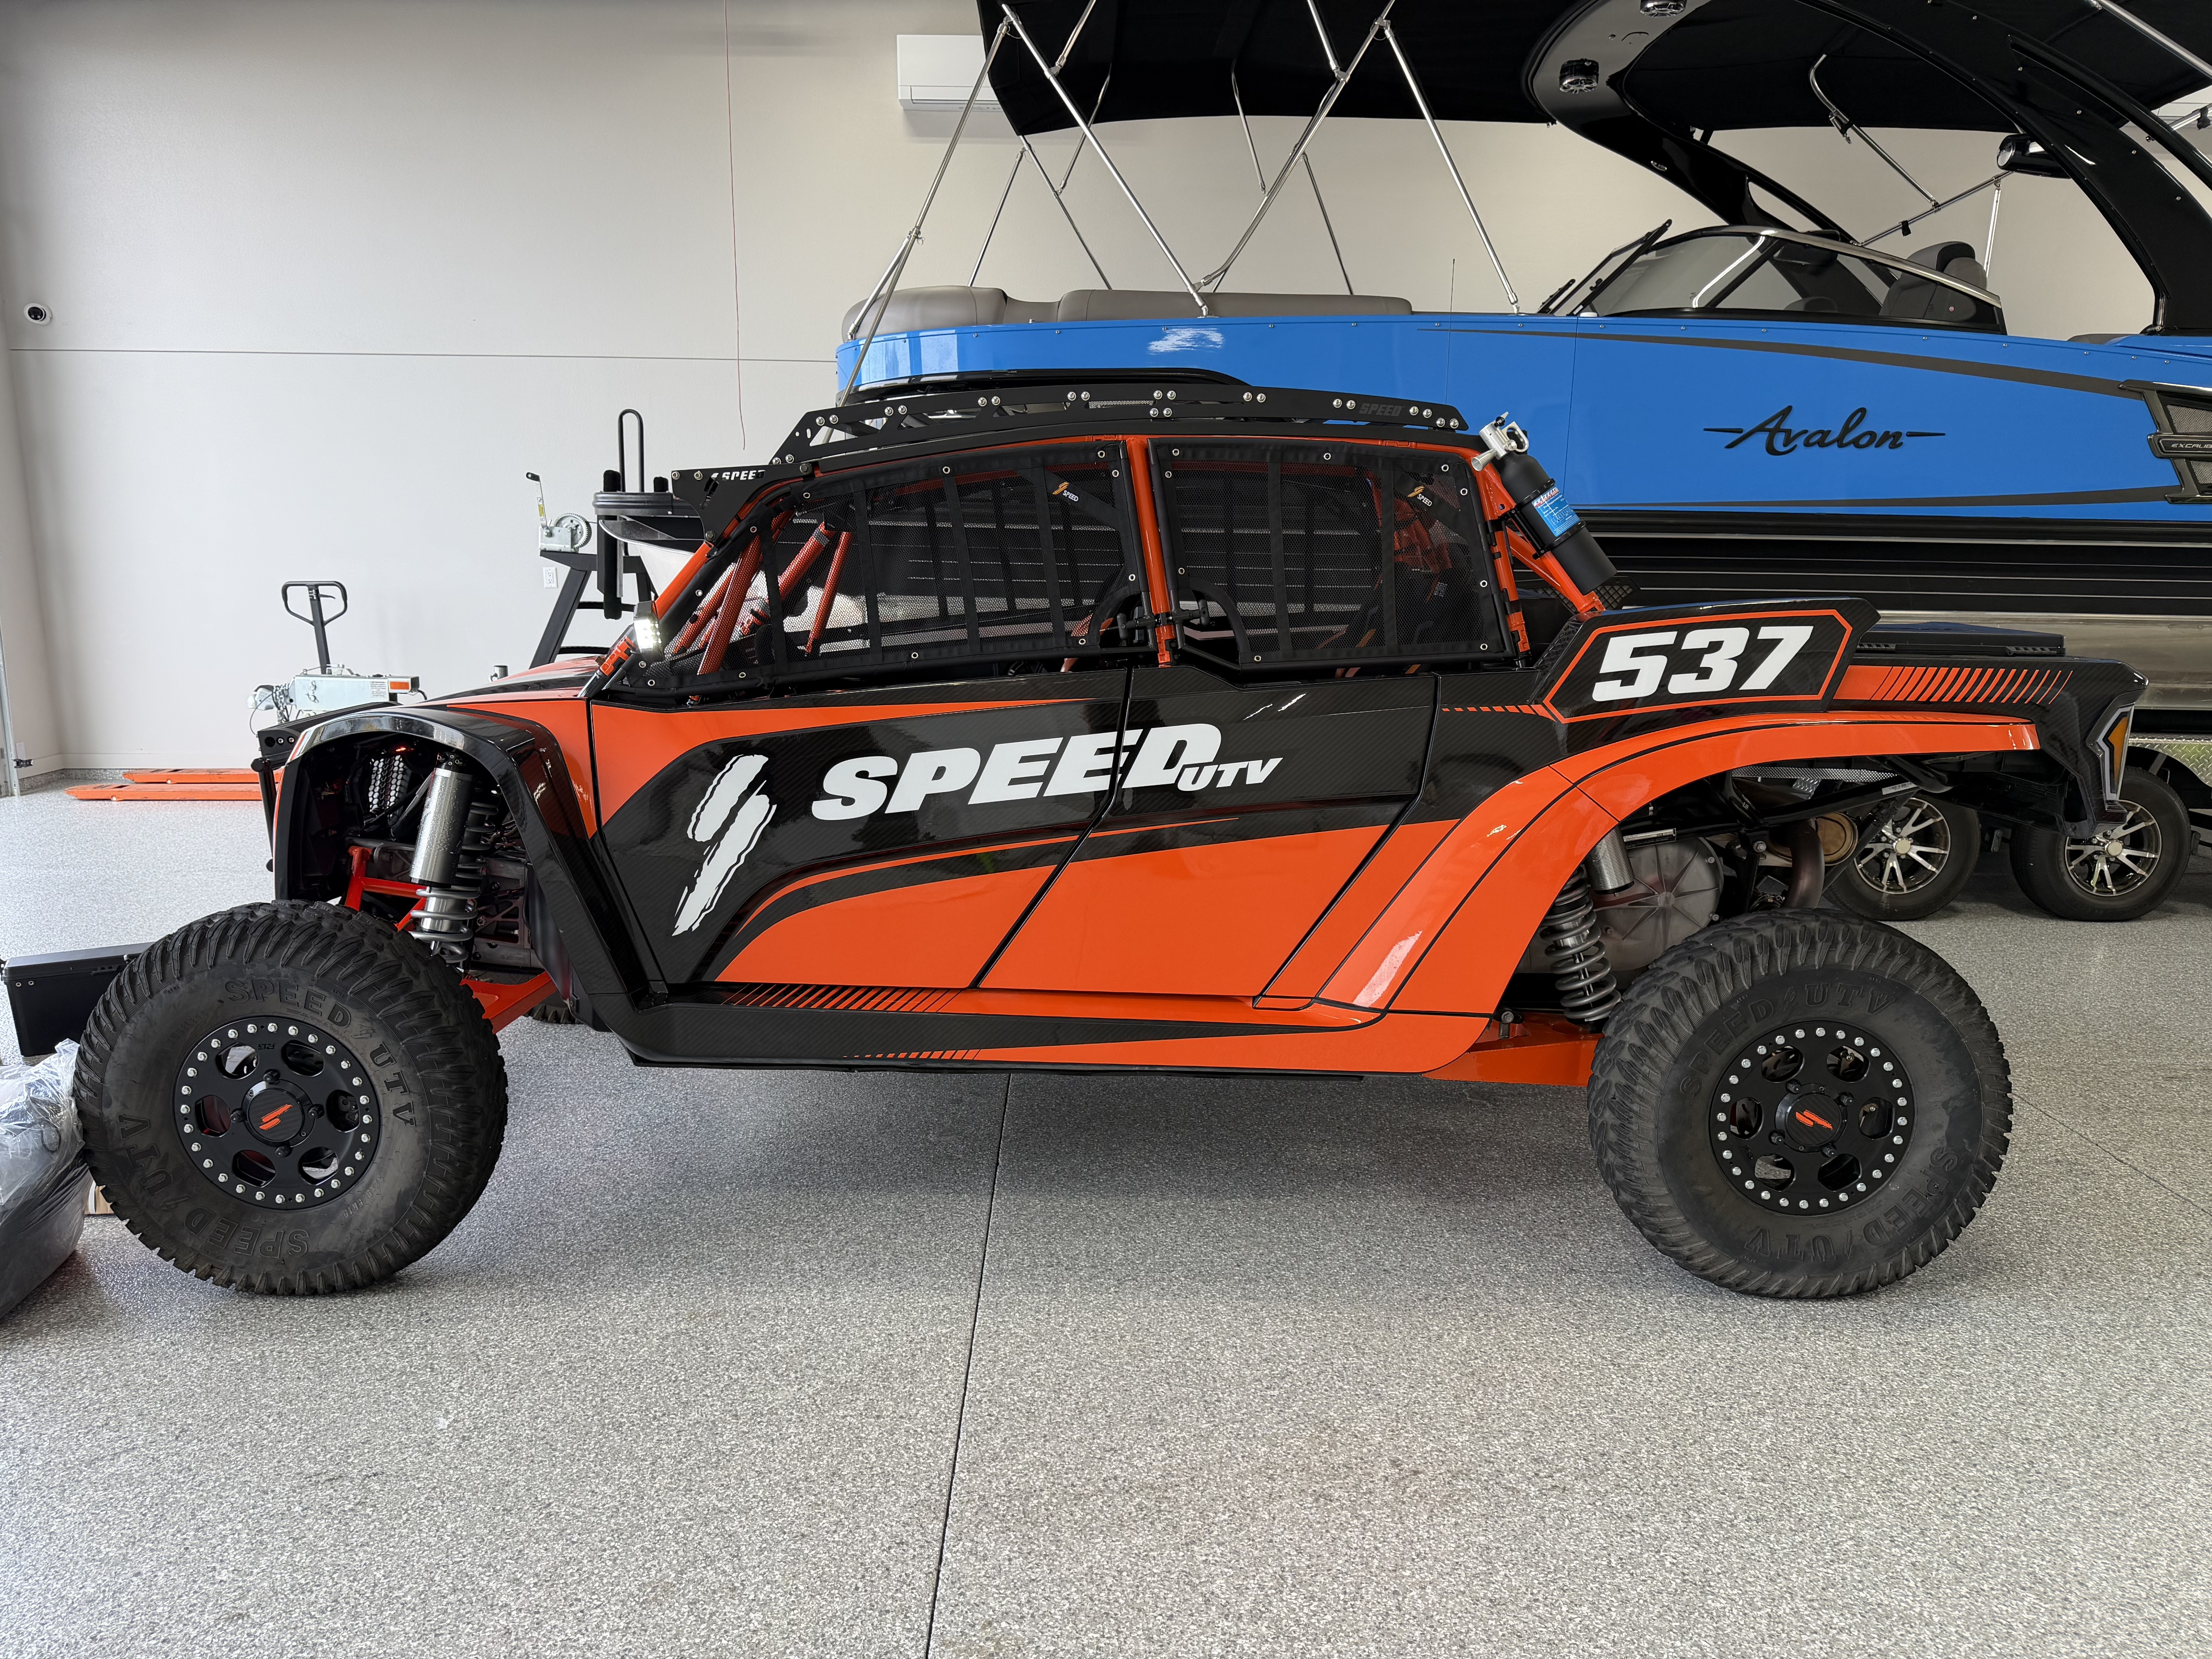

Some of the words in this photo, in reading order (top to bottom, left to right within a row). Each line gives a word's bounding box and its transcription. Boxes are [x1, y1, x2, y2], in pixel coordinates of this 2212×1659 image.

[1359, 403, 1403, 417] SPEED
[1724, 405, 1903, 456] Avalon
[1063, 490, 1079, 501] SPEED
[1417, 493, 1432, 507] SPEED
[1592, 625, 1814, 702] 537
[811, 723, 1222, 820] SPEED
[1177, 757, 1283, 791] UTV
[225, 978, 351, 1028] SPEED
[369, 1042, 417, 1127] UTV
[1680, 998, 1774, 1098] SPEED
[1805, 982, 1896, 1015] UTV
[118, 1115, 173, 1197] UTV
[1863, 1148, 1958, 1246] SPEED
[184, 1207, 310, 1259] SPEED
[1744, 1226, 1837, 1262] UTV
